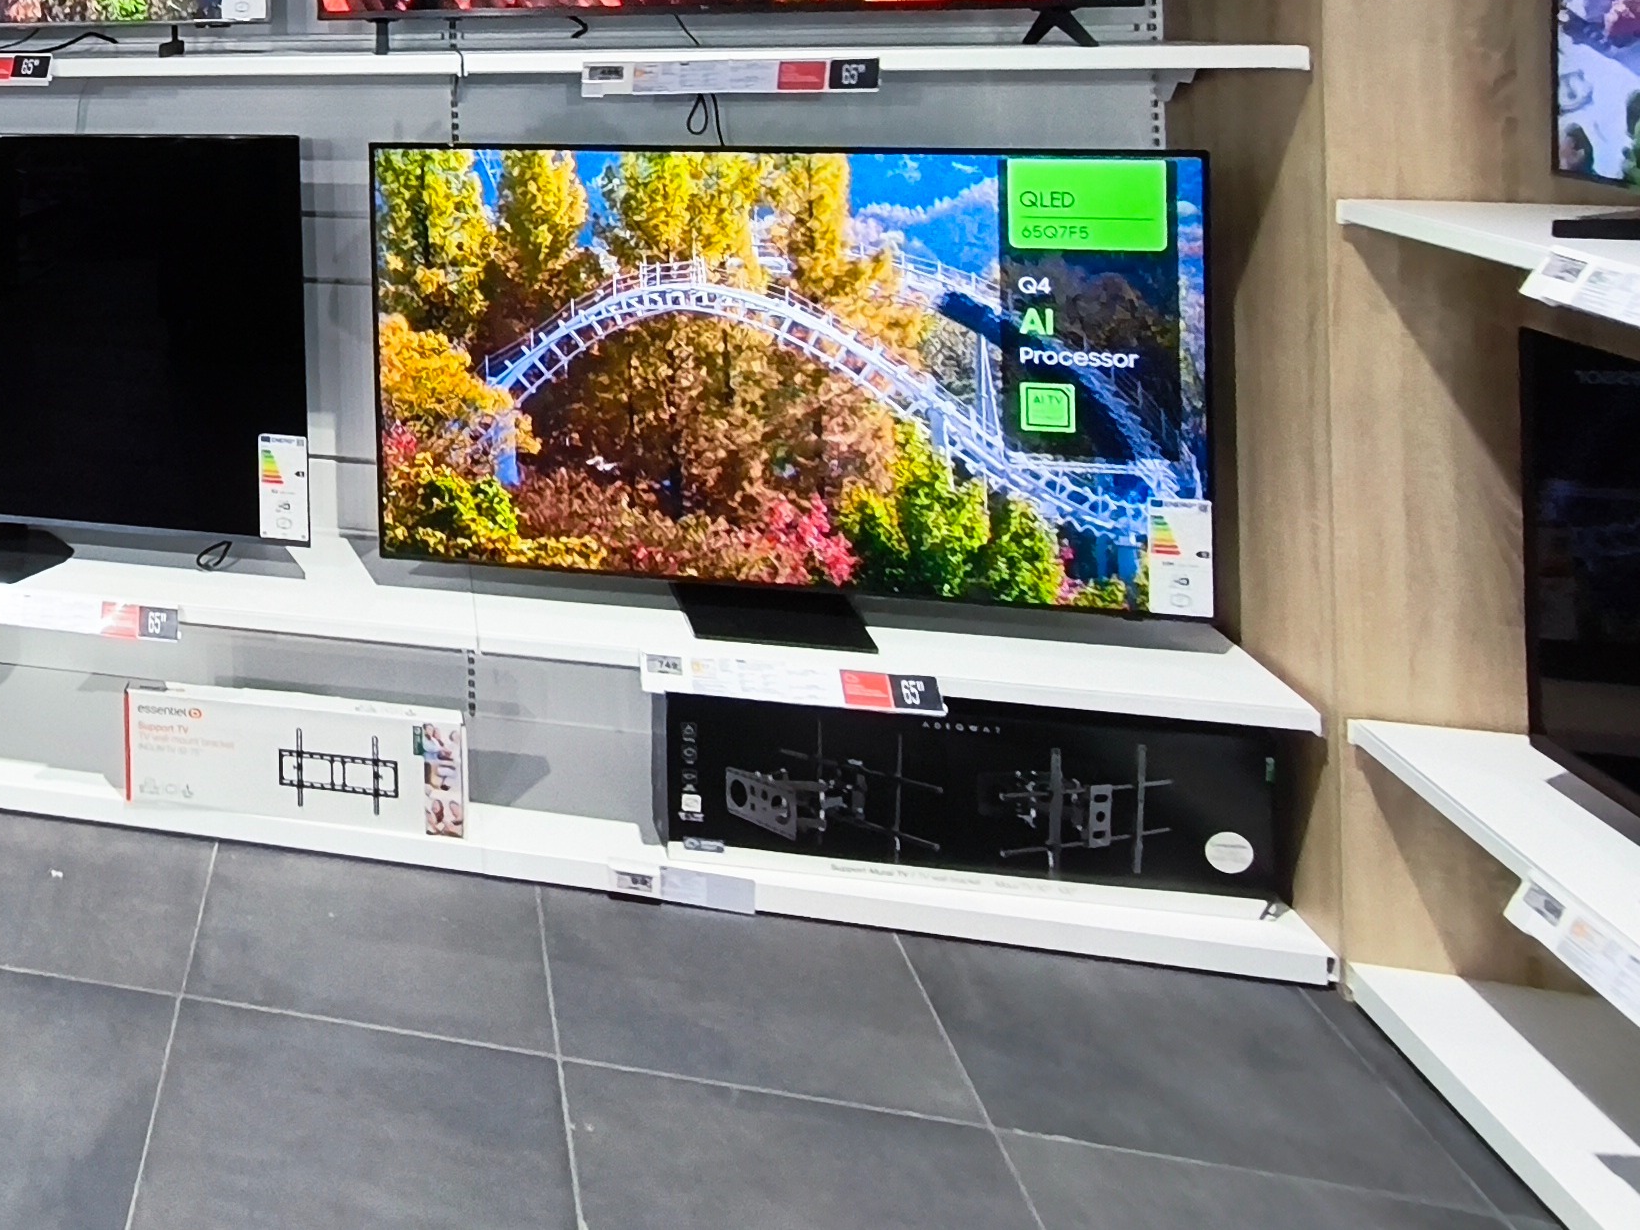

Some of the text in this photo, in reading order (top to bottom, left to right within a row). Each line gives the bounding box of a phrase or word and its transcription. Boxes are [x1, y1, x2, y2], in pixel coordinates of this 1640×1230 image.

[1019, 190, 1076, 209] QLED
[1021, 225, 1090, 240] 65Q7F5
[1018, 276, 1052, 295] Q4
[1019, 307, 1055, 336] AI
[1019, 346, 1140, 368] Processor
[1033, 394, 1064, 404] AI TV
[148, 611, 167, 634] 65"
[900, 679, 926, 705] 65"
[137, 704, 188, 718] essentiel
